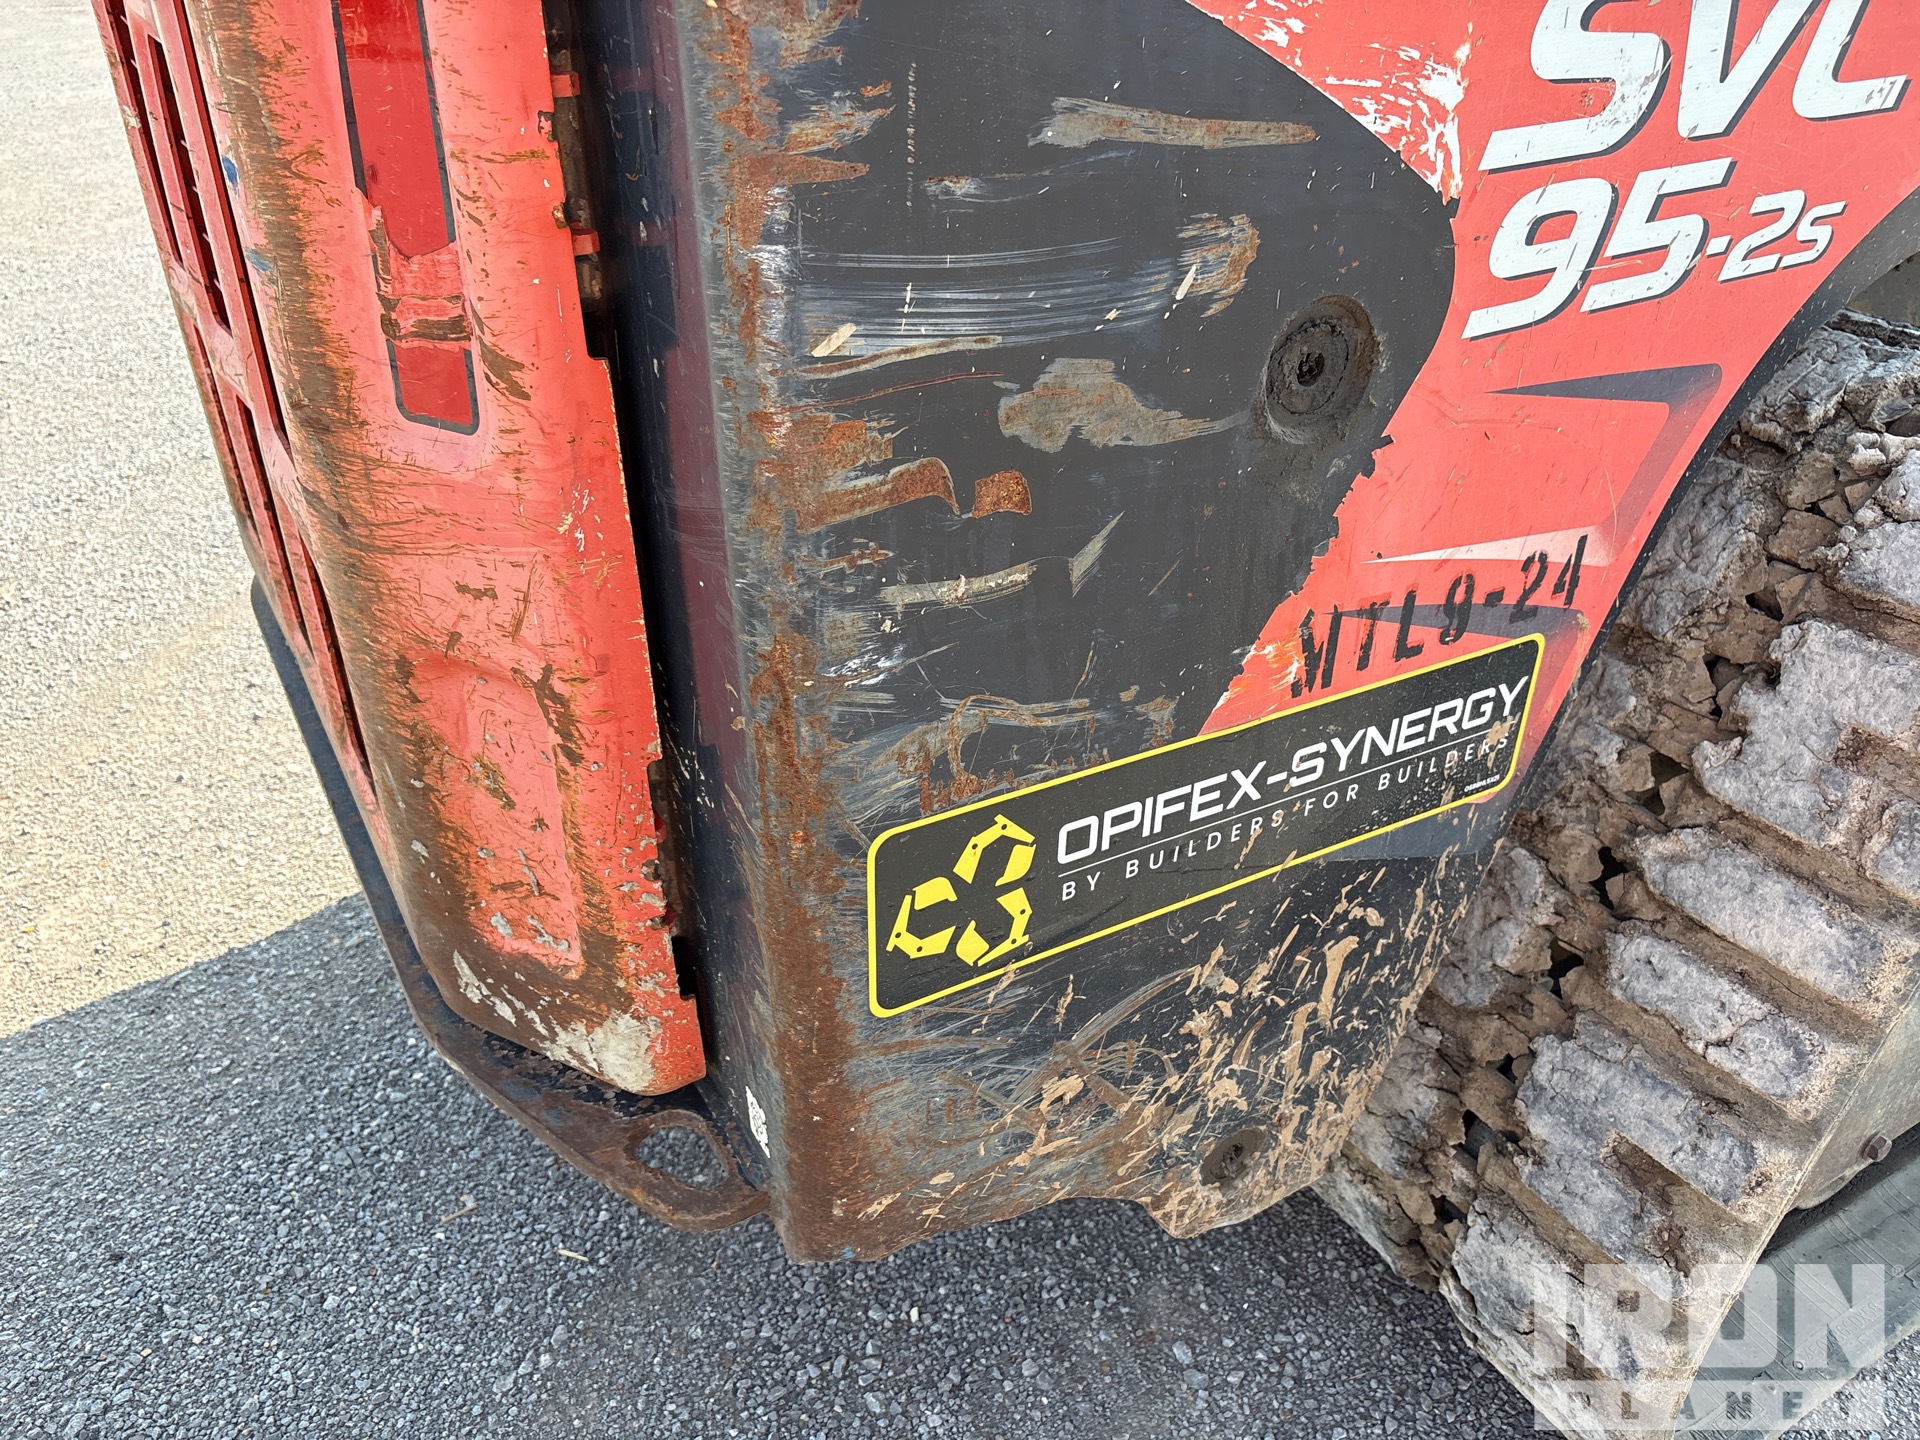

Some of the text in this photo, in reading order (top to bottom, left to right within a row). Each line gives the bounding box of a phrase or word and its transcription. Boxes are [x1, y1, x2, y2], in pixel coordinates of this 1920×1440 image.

[1478, 0, 1908, 173] SVL
[1057, 676, 1529, 865] OPIFEX-SYNERGY
[1061, 871, 1101, 901] BY
[1125, 809, 1284, 879] BUILDERS
[1303, 784, 1359, 817] FOR
[1377, 732, 1508, 791] BUILDERS
